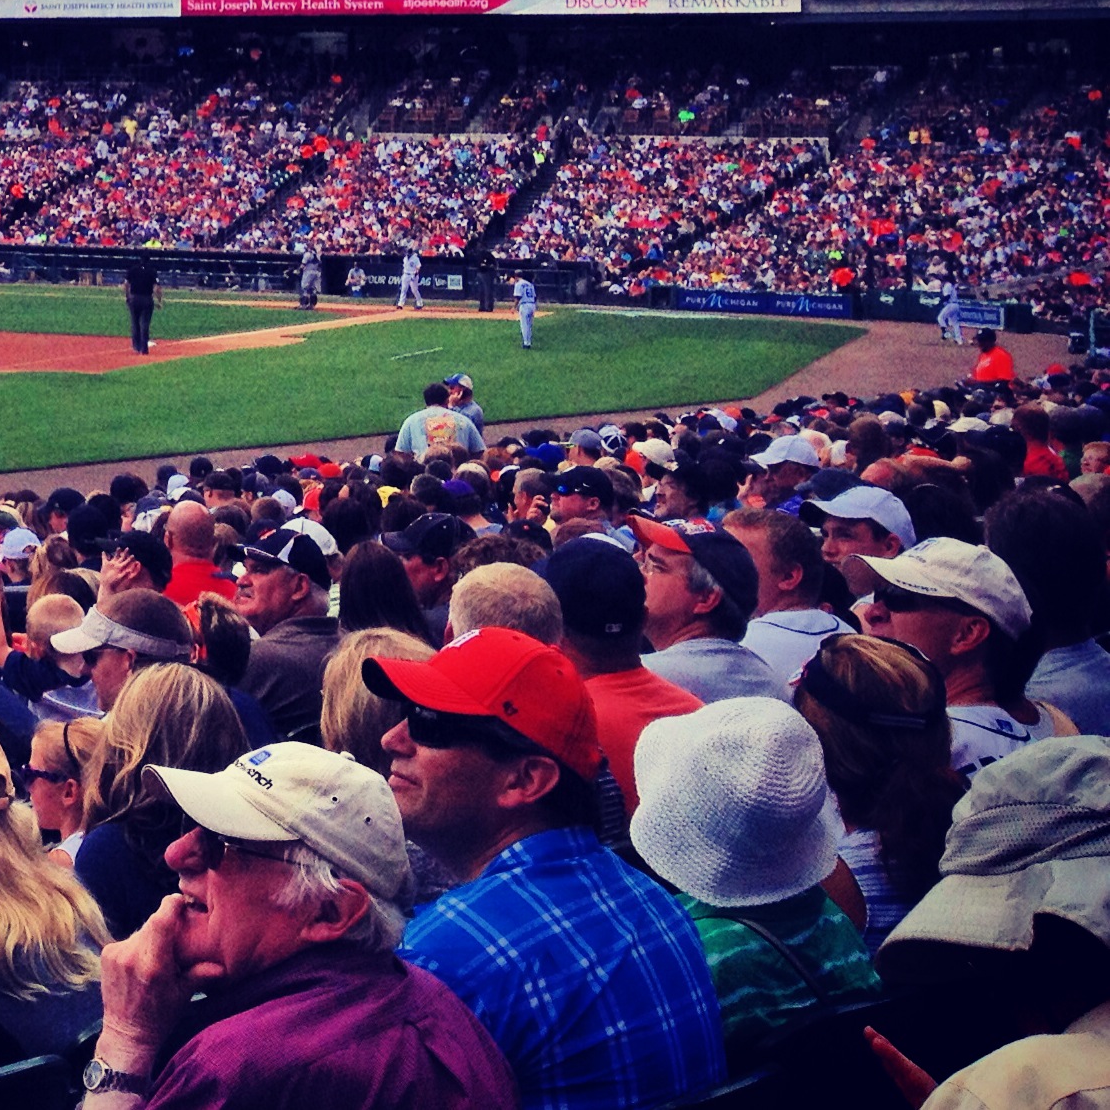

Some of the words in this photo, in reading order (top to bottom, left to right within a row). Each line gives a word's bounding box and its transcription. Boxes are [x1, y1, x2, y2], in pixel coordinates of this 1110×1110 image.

[187, 0, 217, 11] Saint
[219, 0, 257, 13] Joseph
[260, 0, 297, 12] Mercy
[388, 276, 402, 285] OW
